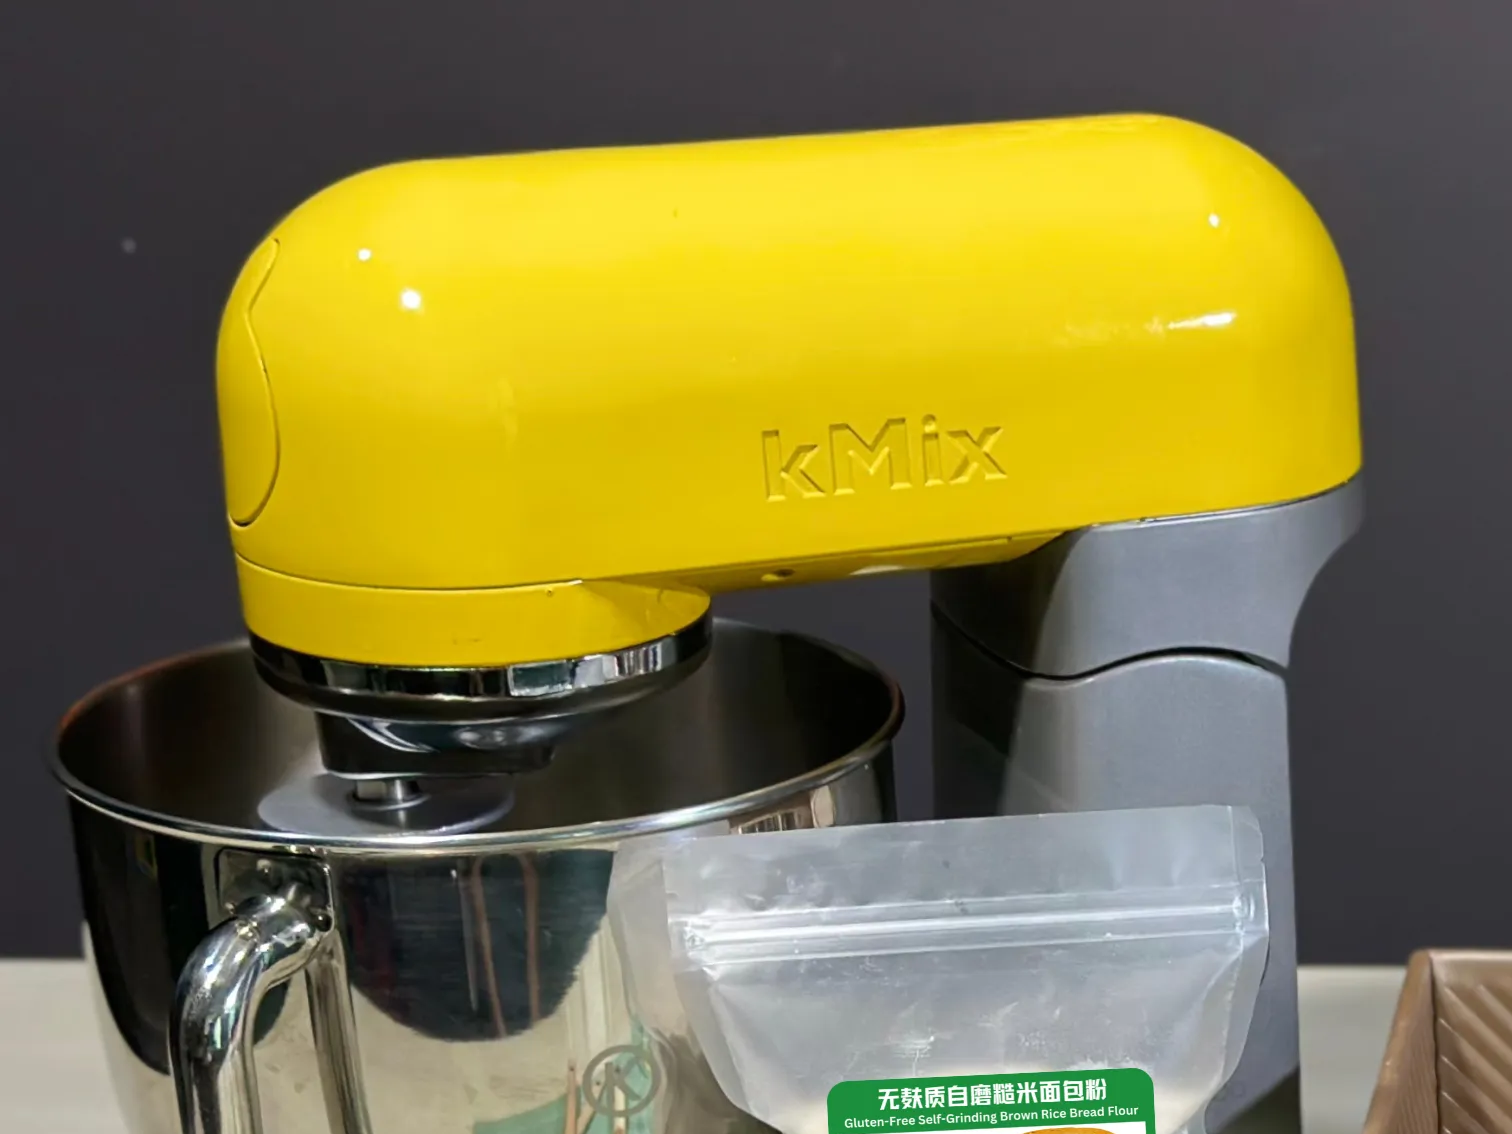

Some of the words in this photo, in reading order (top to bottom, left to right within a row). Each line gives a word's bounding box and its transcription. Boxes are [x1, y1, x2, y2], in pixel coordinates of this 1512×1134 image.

[761, 414, 1008, 502] kMix
[844, 1116, 915, 1128] Gluten-Free
[918, 1112, 997, 1125] Self-Grinding
[1000, 1111, 1038, 1121] Brown
[1041, 1109, 1066, 1119] Rice
[1070, 1106, 1104, 1118] Bread
[1108, 1106, 1139, 1116] Flour
